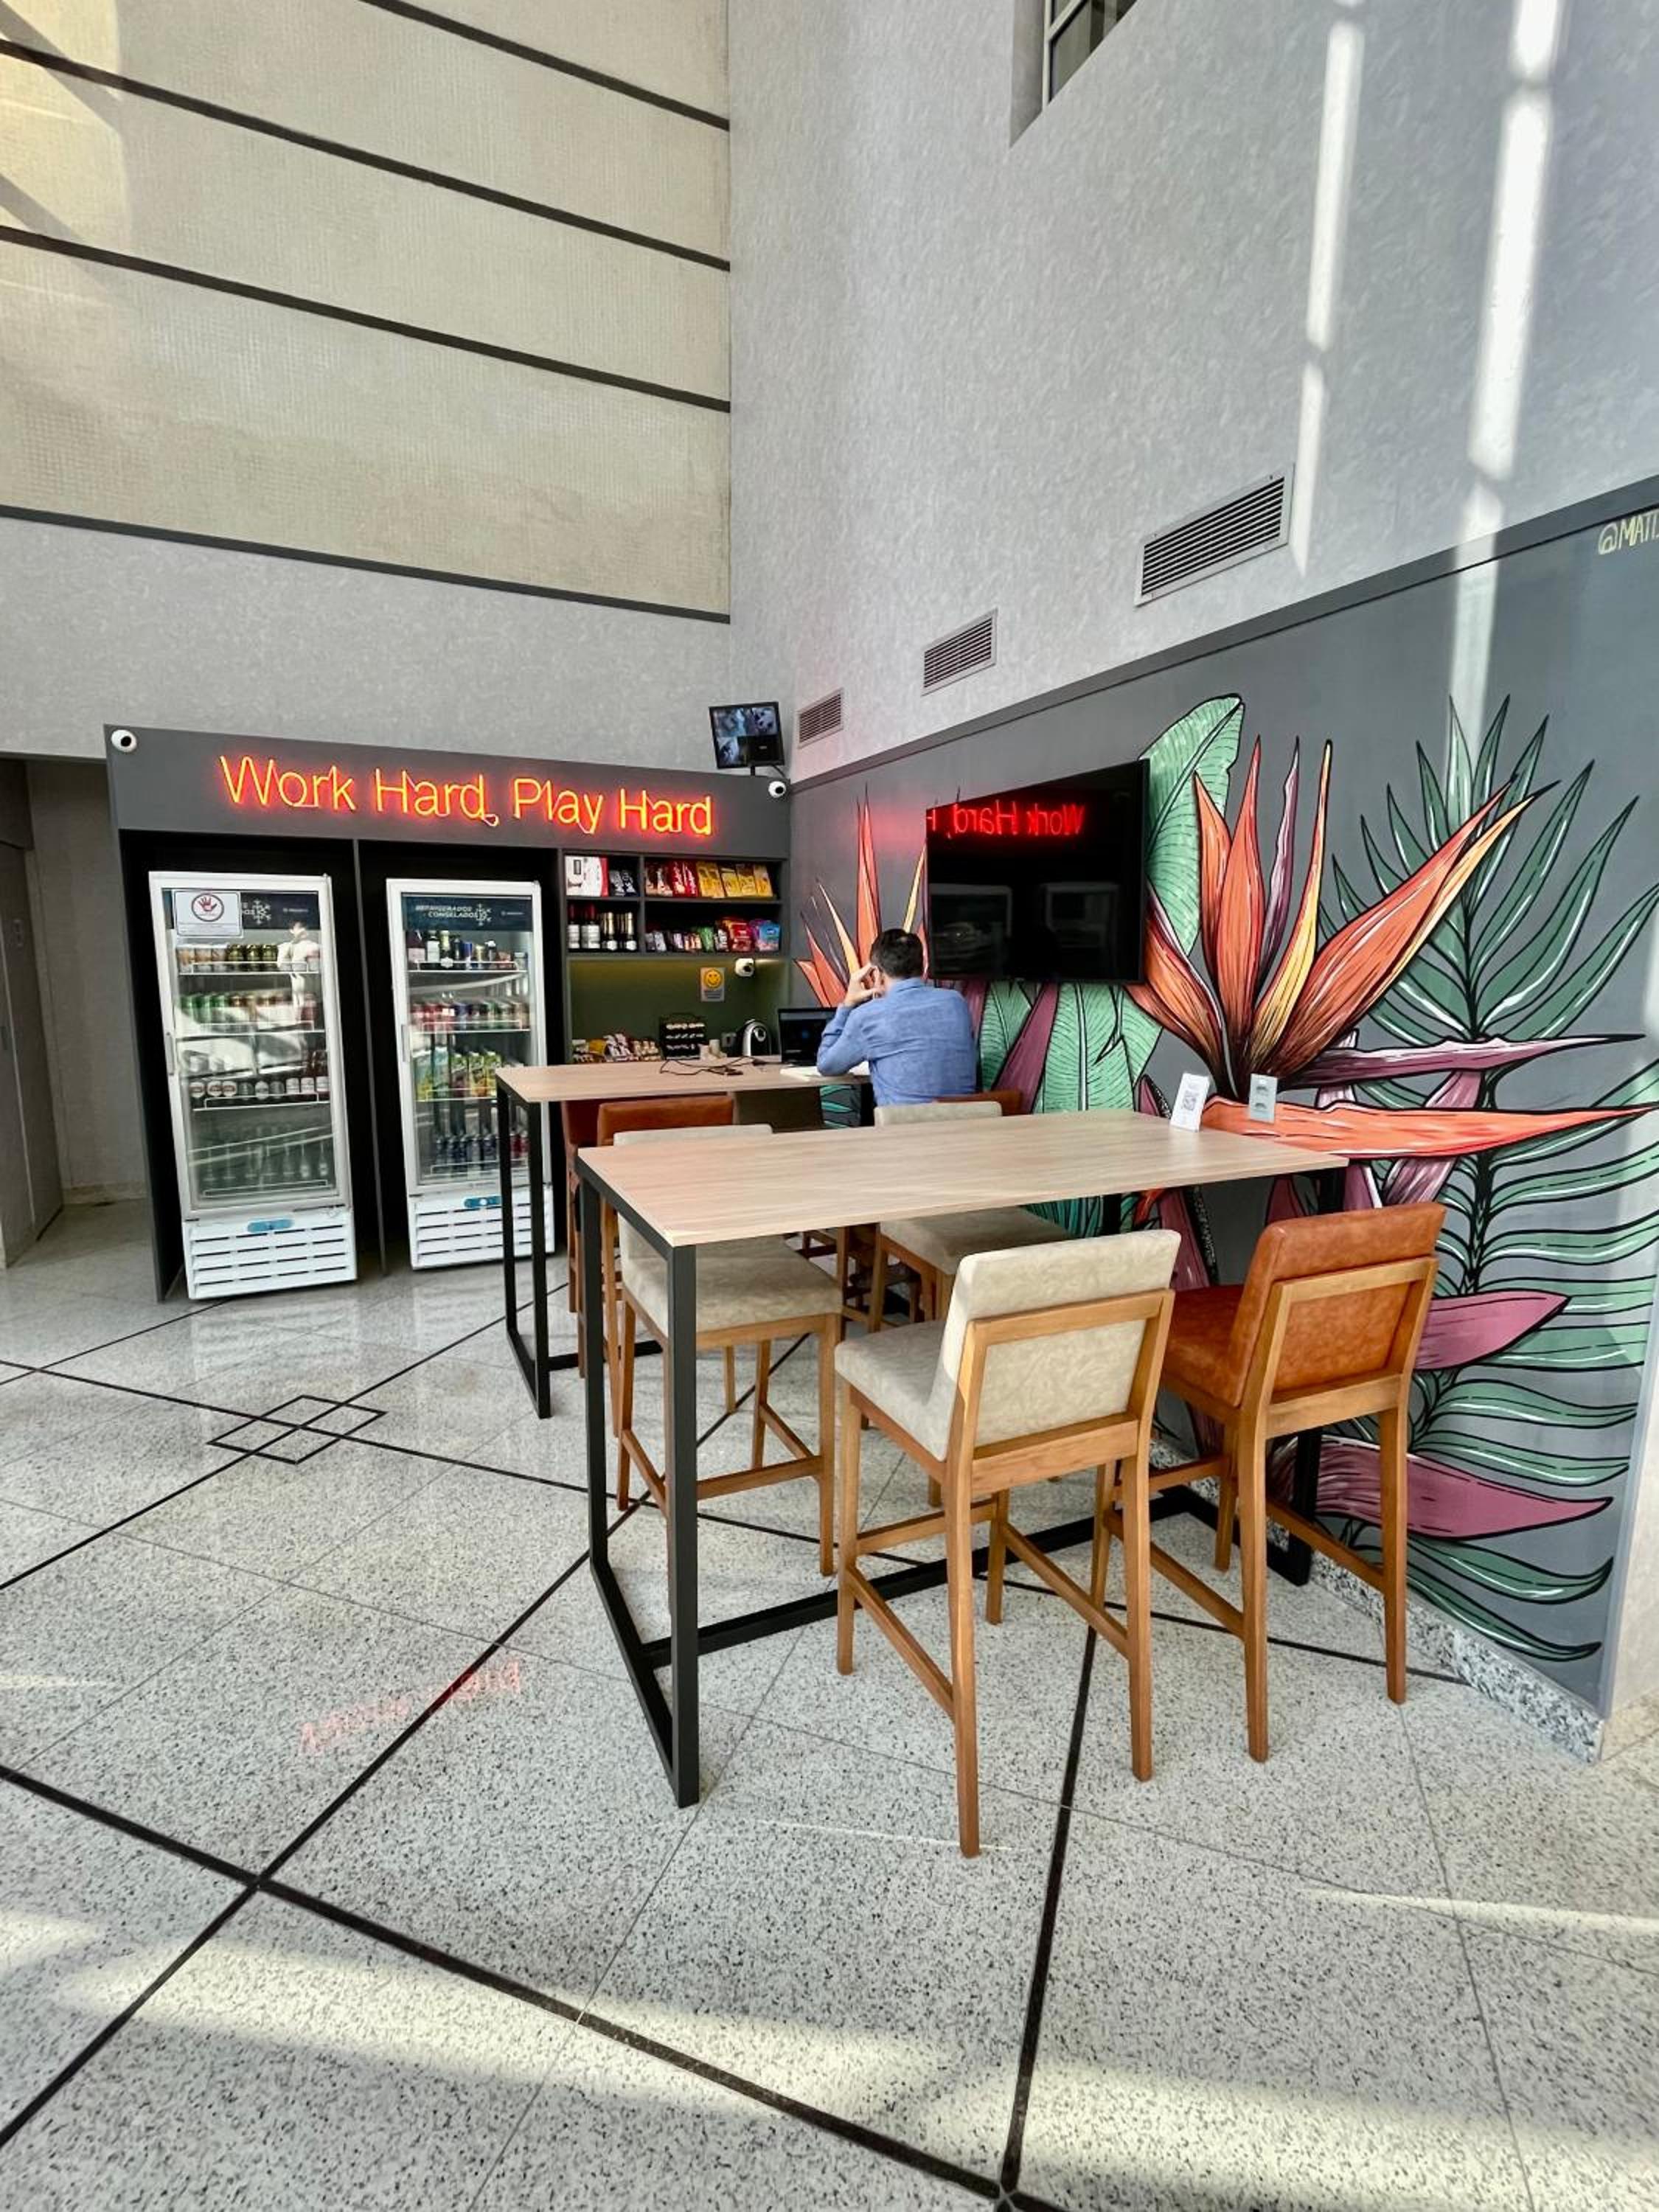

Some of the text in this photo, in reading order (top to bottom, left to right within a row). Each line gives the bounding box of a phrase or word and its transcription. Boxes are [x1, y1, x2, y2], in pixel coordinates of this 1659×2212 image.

[1598, 509, 1659, 555] @MATT
[220, 755, 357, 811] Work
[513, 778, 603, 835] Play
[620, 787, 712, 835] Hard
